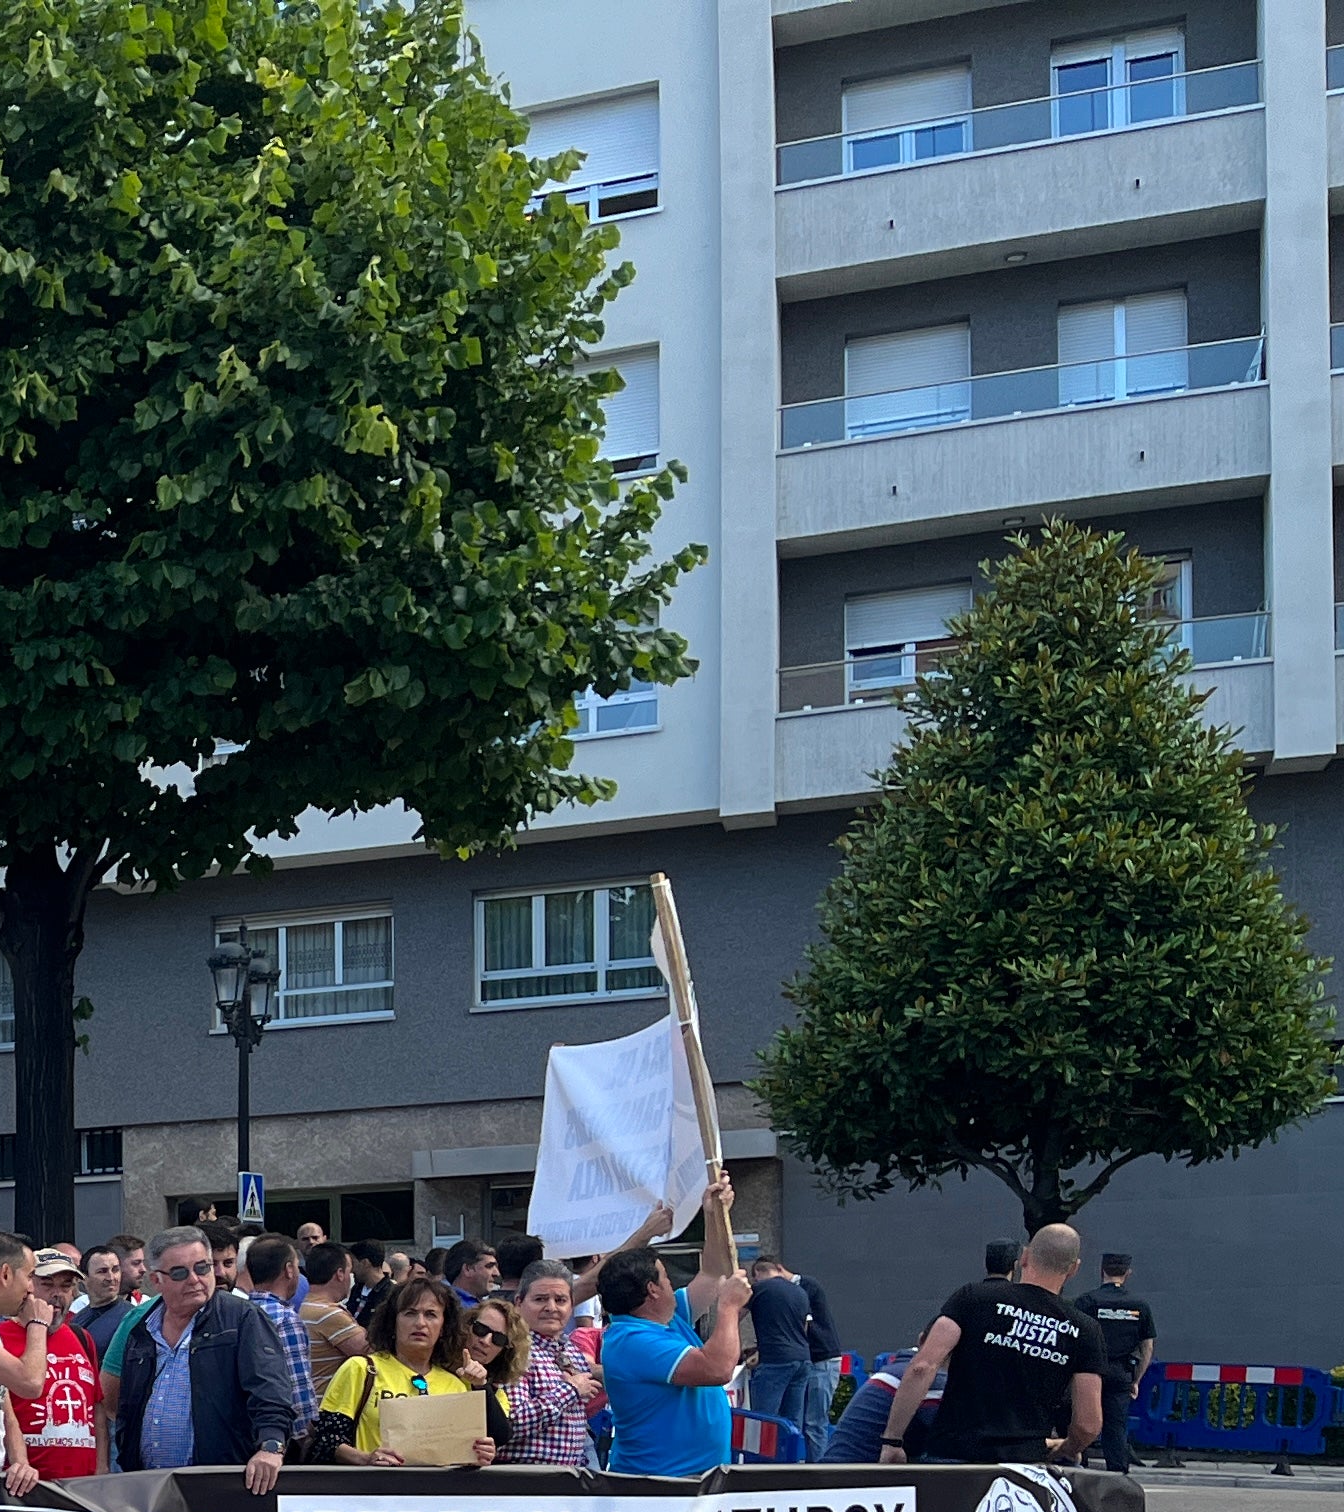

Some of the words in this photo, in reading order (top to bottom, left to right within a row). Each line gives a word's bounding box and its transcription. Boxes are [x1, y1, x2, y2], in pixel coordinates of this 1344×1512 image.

[996, 1303, 1080, 1339] TRANSICIÓN
[1007, 1319, 1058, 1347] JUSTA
[983, 1332, 1021, 1352] PARA
[1022, 1343, 1070, 1366] TODOS
